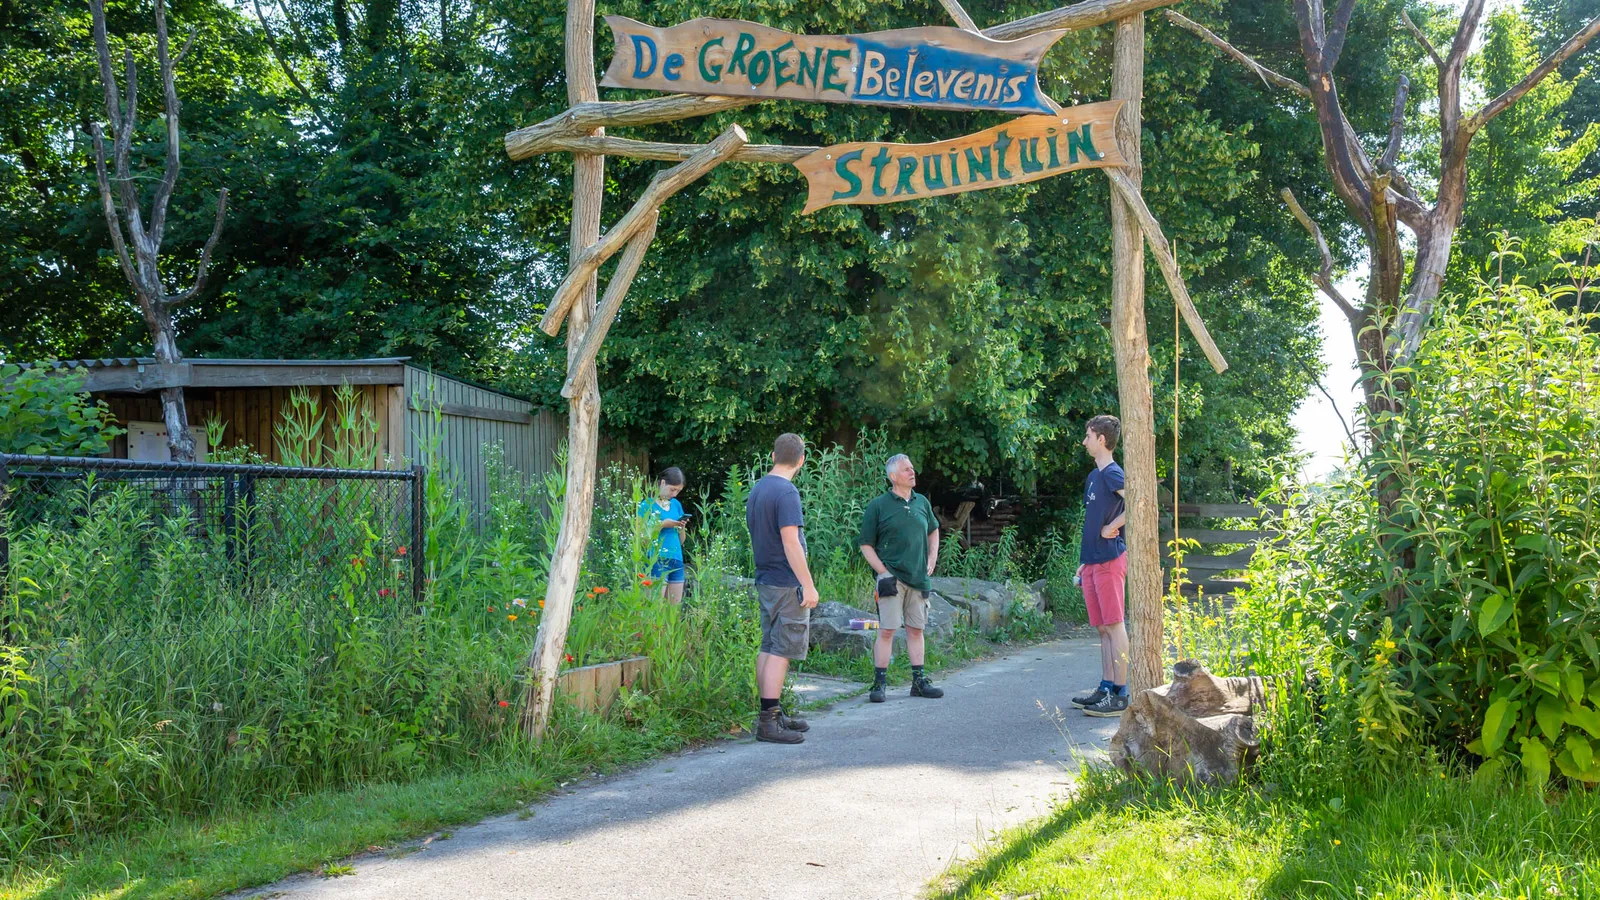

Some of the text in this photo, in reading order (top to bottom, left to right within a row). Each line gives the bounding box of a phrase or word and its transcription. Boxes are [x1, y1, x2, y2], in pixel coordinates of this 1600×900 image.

[630, 32, 1029, 103] De GROENE Belevenis
